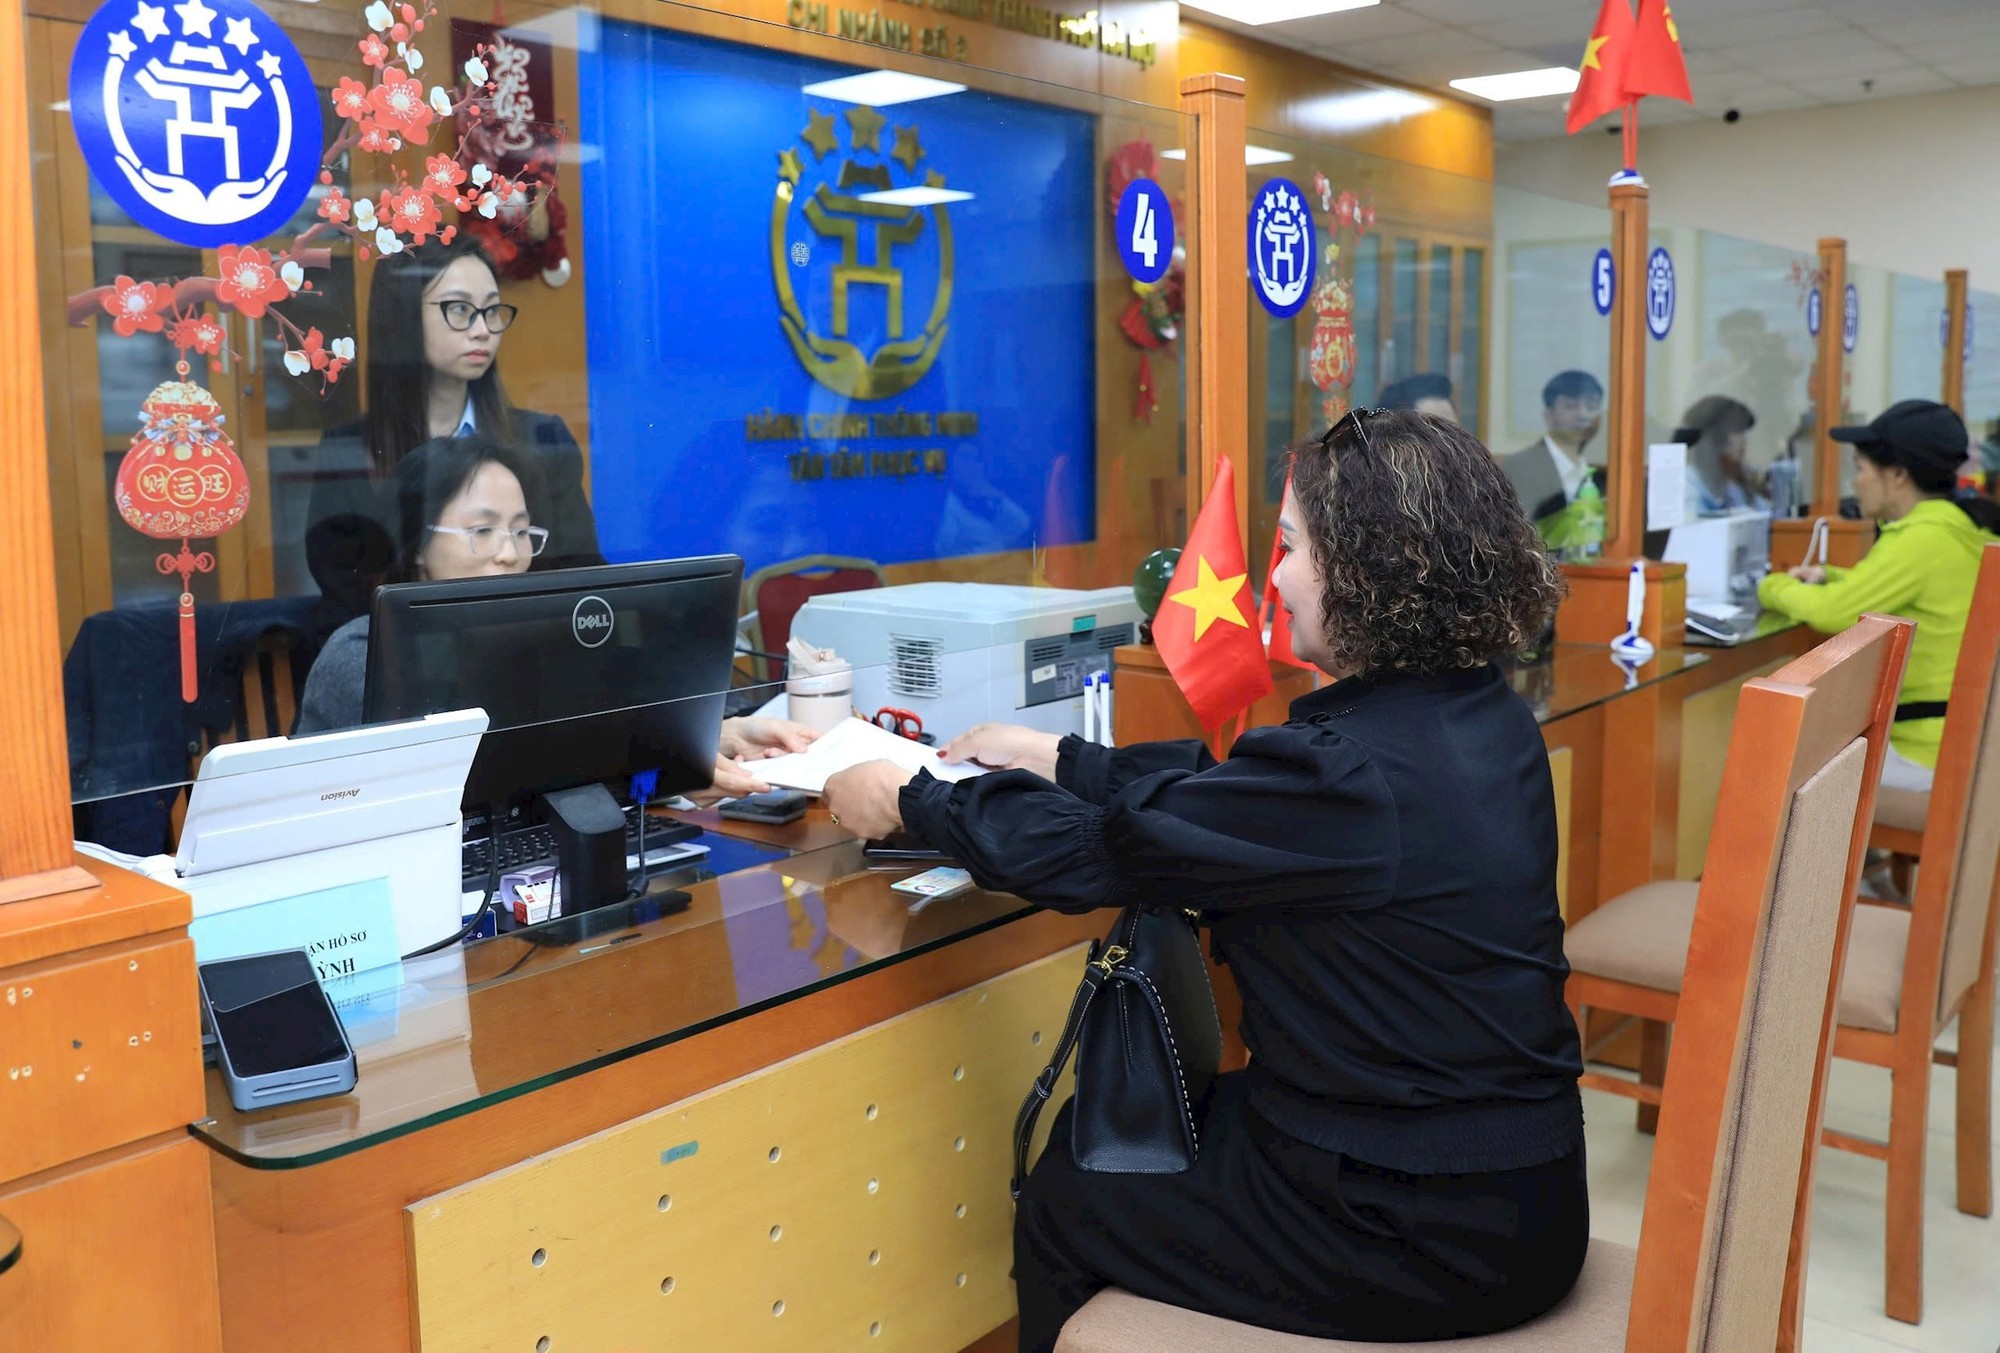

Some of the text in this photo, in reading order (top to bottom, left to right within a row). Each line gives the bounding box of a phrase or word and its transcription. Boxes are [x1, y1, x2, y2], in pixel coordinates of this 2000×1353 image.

[1132, 192, 1158, 268] 4
[1597, 256, 1612, 308] 5
[577, 614, 610, 630] DELL
[320, 788, 361, 801] Avision
[308, 930, 367, 957] ẬN HỒ SƠ
[317, 957, 355, 980] ỲNH
